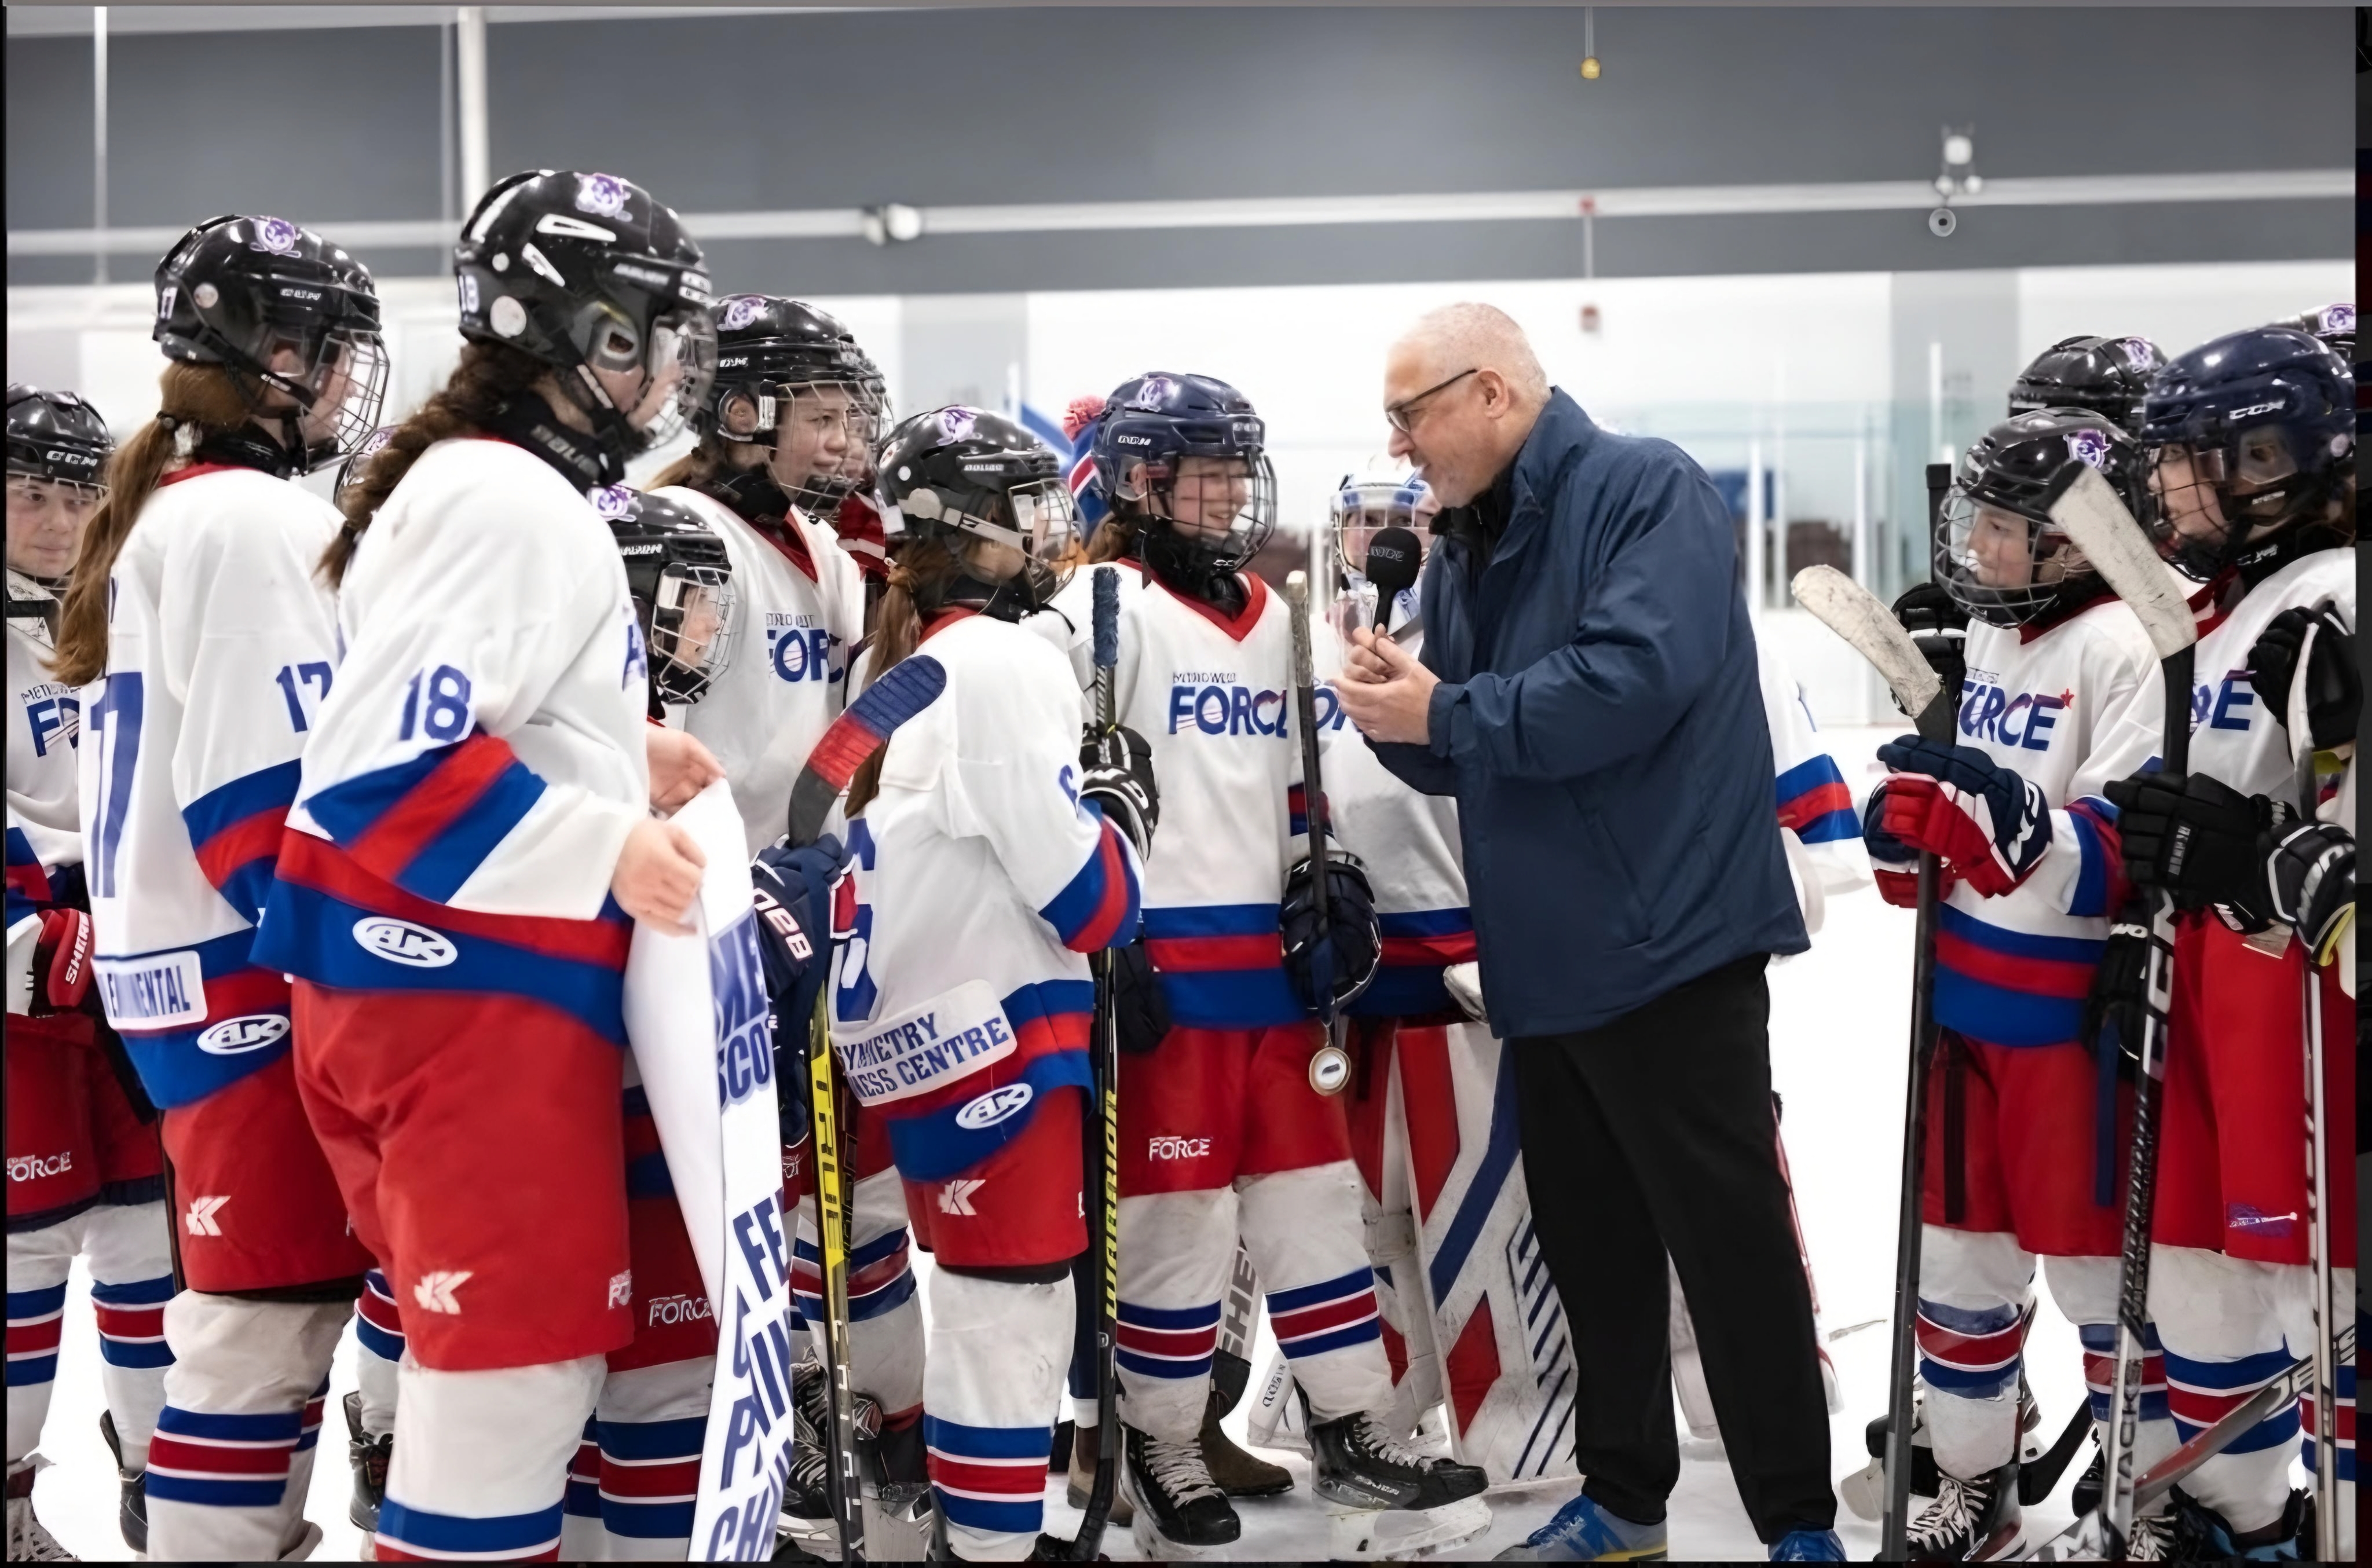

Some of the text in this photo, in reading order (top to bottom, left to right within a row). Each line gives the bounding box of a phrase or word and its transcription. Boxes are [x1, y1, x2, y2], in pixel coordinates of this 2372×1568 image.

[276, 661, 334, 733] 17
[400, 664, 471, 743] 18
[896, 1016, 1009, 1086] CENTRE
[1149, 1138, 1211, 1162] FORCE
